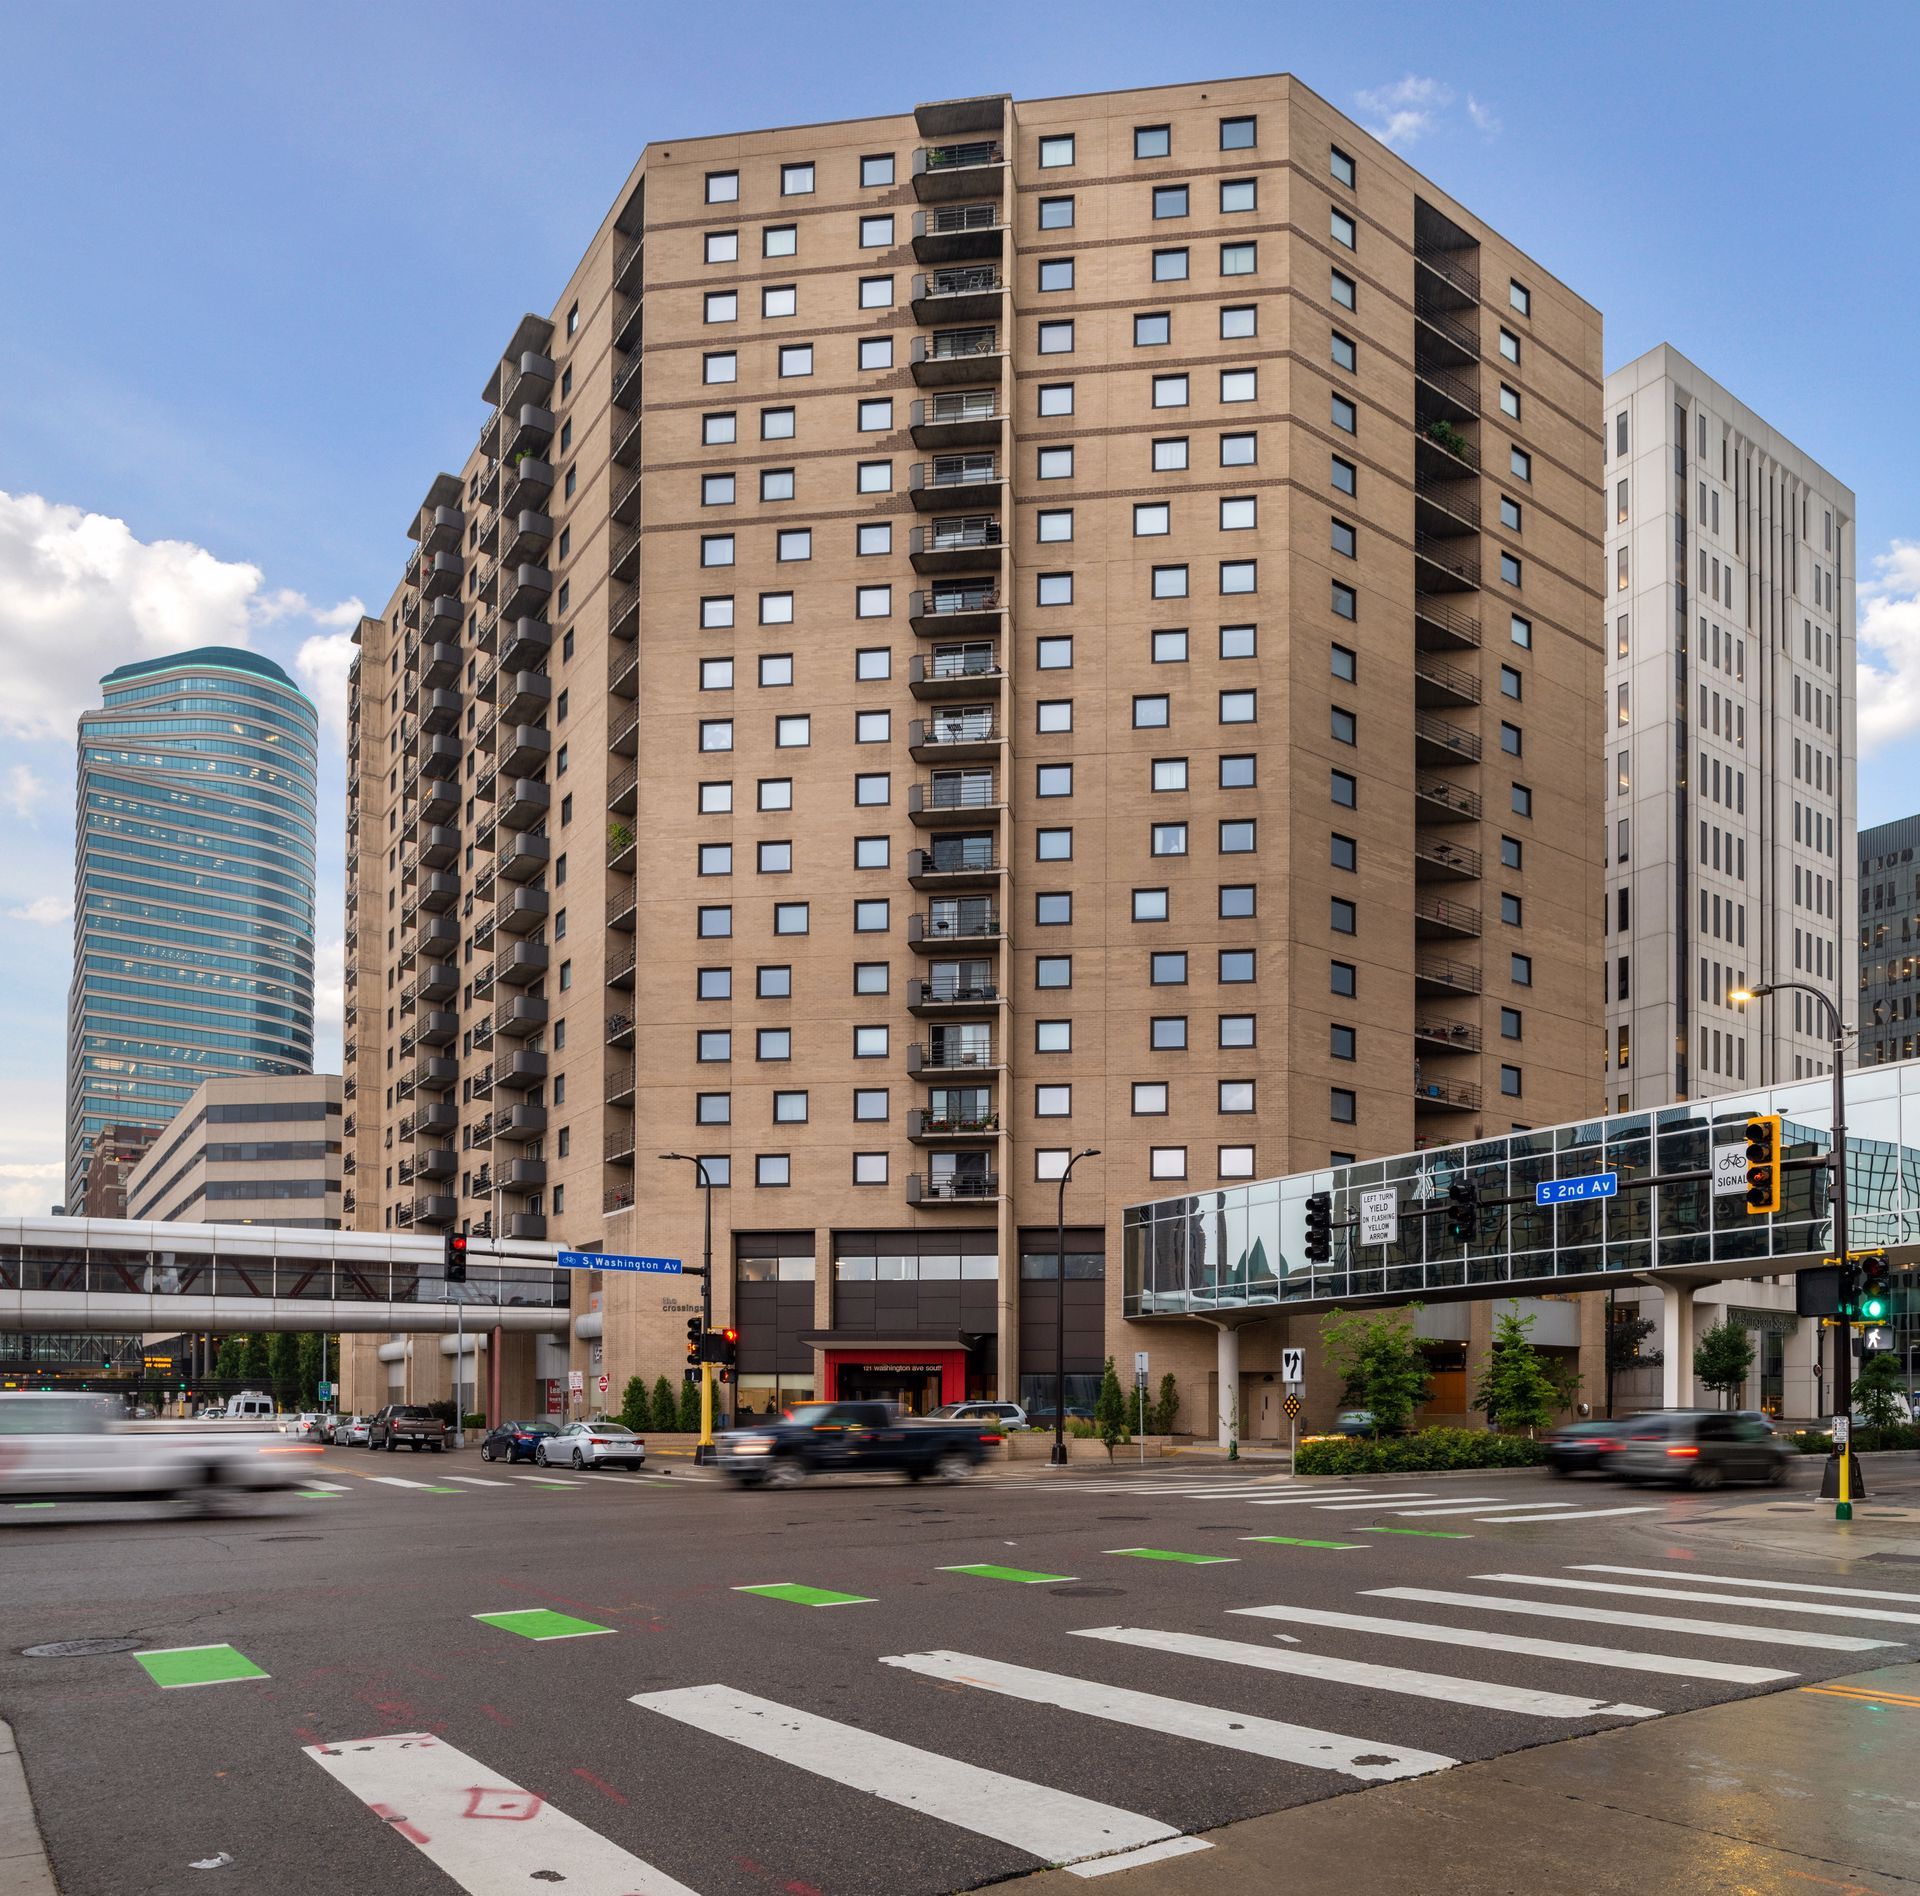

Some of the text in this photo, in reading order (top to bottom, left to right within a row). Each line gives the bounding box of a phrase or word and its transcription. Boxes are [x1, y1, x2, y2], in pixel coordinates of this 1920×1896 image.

[1718, 1174, 1748, 1187] SIGNAL
[1543, 1181, 1610, 1199] S 2nd Av
[1364, 1193, 1394, 1203] LEFT TURN
[1369, 1203, 1389, 1212] YIELD
[1372, 1213, 1395, 1222] FLASHING
[1368, 1223, 1390, 1231] YELLOW
[1370, 1232, 1388, 1240] ARROW
[595, 1258, 659, 1270] Washington
[664, 1262, 678, 1271] Av
[662, 1304, 705, 1313] crossings
[874, 1364, 911, 1372] washington
